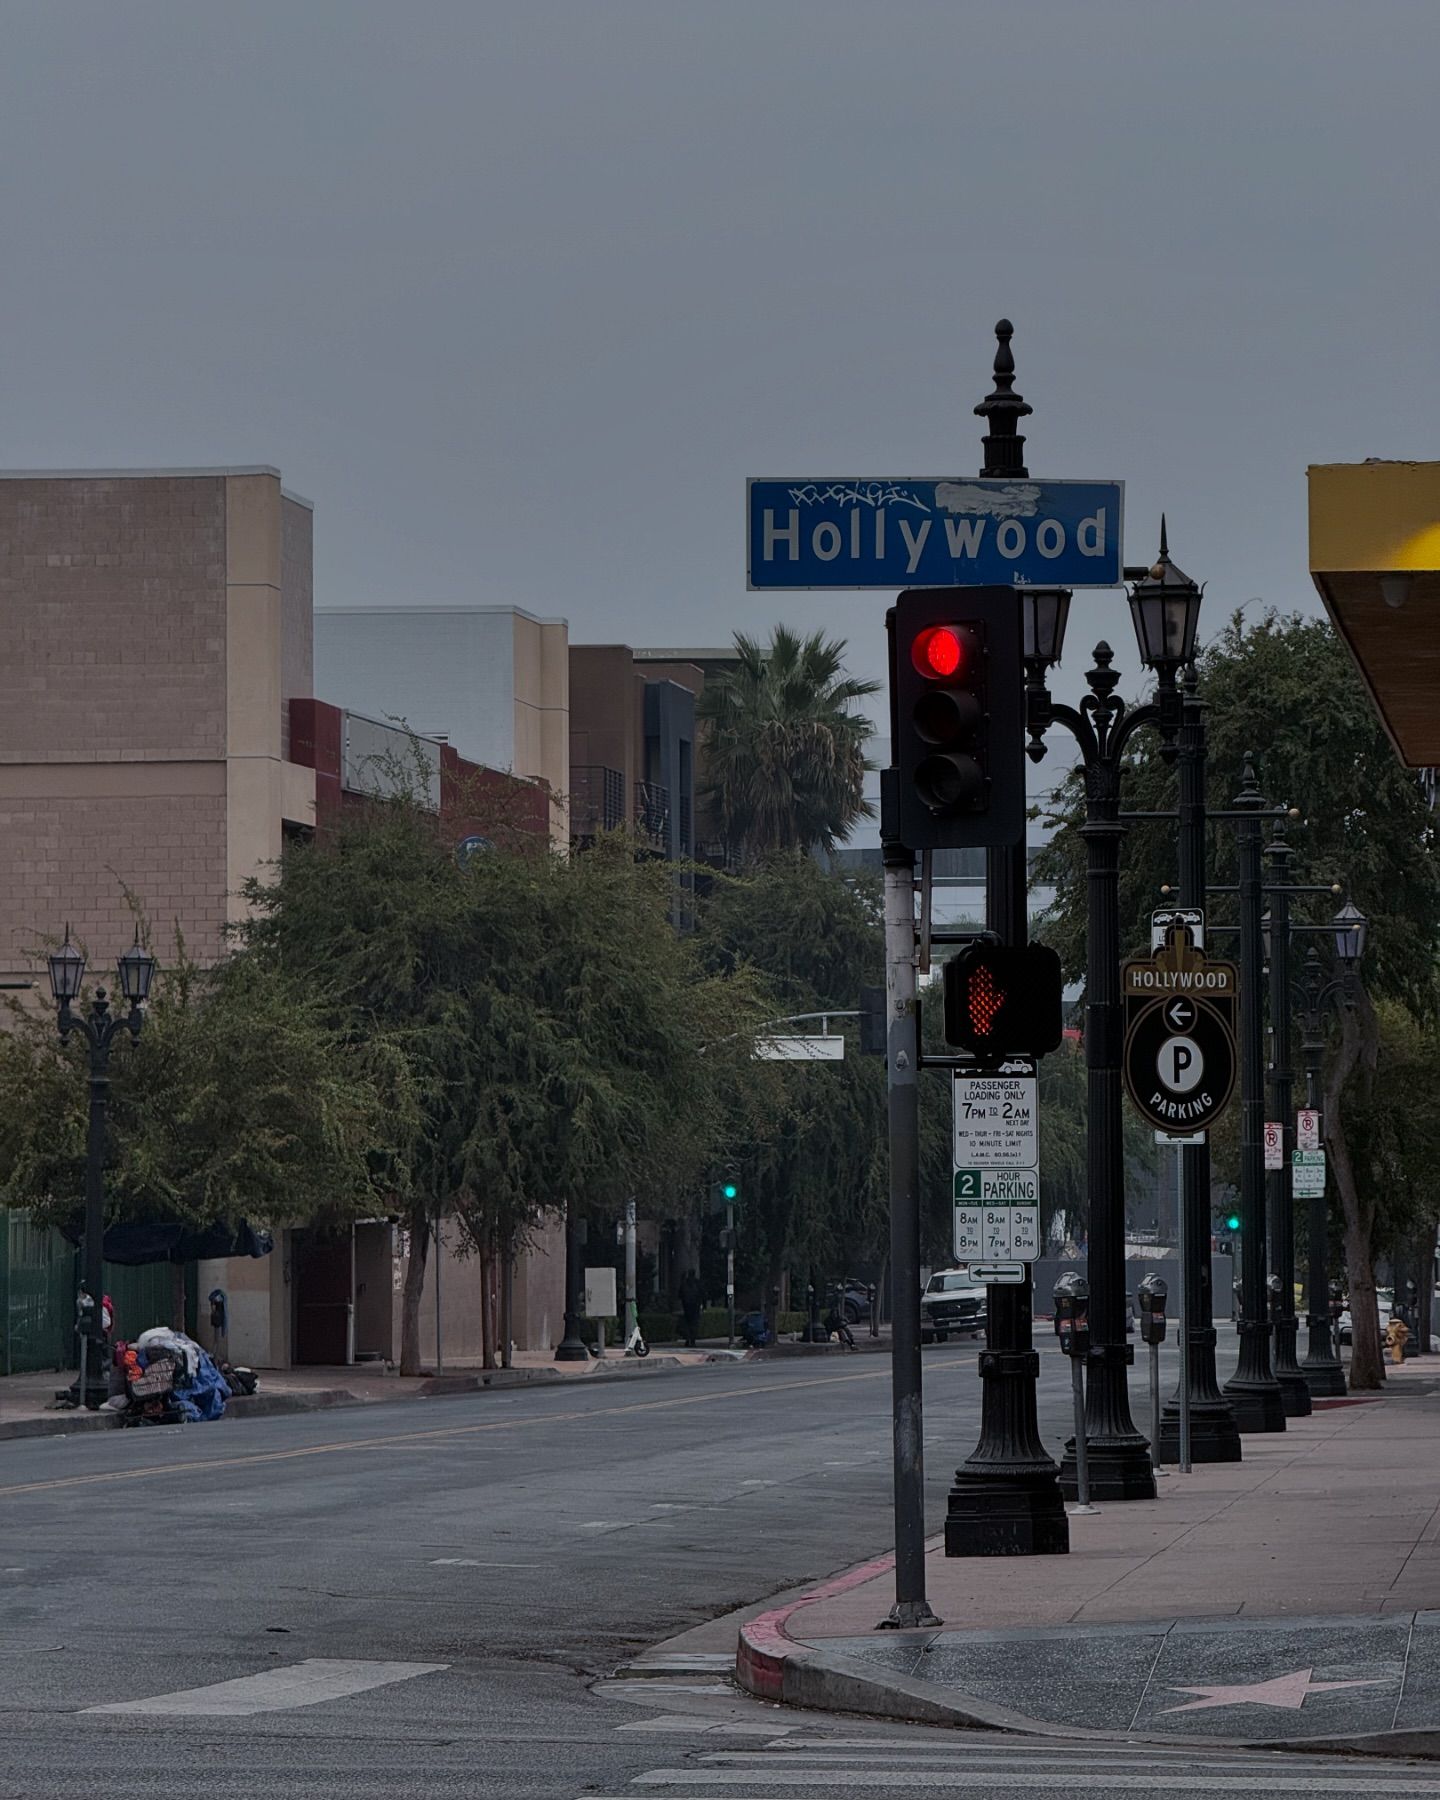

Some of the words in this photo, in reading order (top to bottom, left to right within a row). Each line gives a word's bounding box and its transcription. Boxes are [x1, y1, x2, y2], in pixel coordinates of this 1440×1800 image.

[763, 507, 1106, 573] Hollywood
[1133, 971, 1228, 988] HOLLYWOOD
[1173, 1045, 1192, 1084] P
[964, 1091, 1000, 1100] LOADING
[1004, 1091, 1026, 1100] ONLY
[970, 1081, 1020, 1090] PASSENGER
[1149, 1091, 1213, 1119] PARKING
[961, 1174, 974, 1195] 2
[997, 1172, 1021, 1181] HOUR
[983, 1182, 1034, 1199] PARKING
